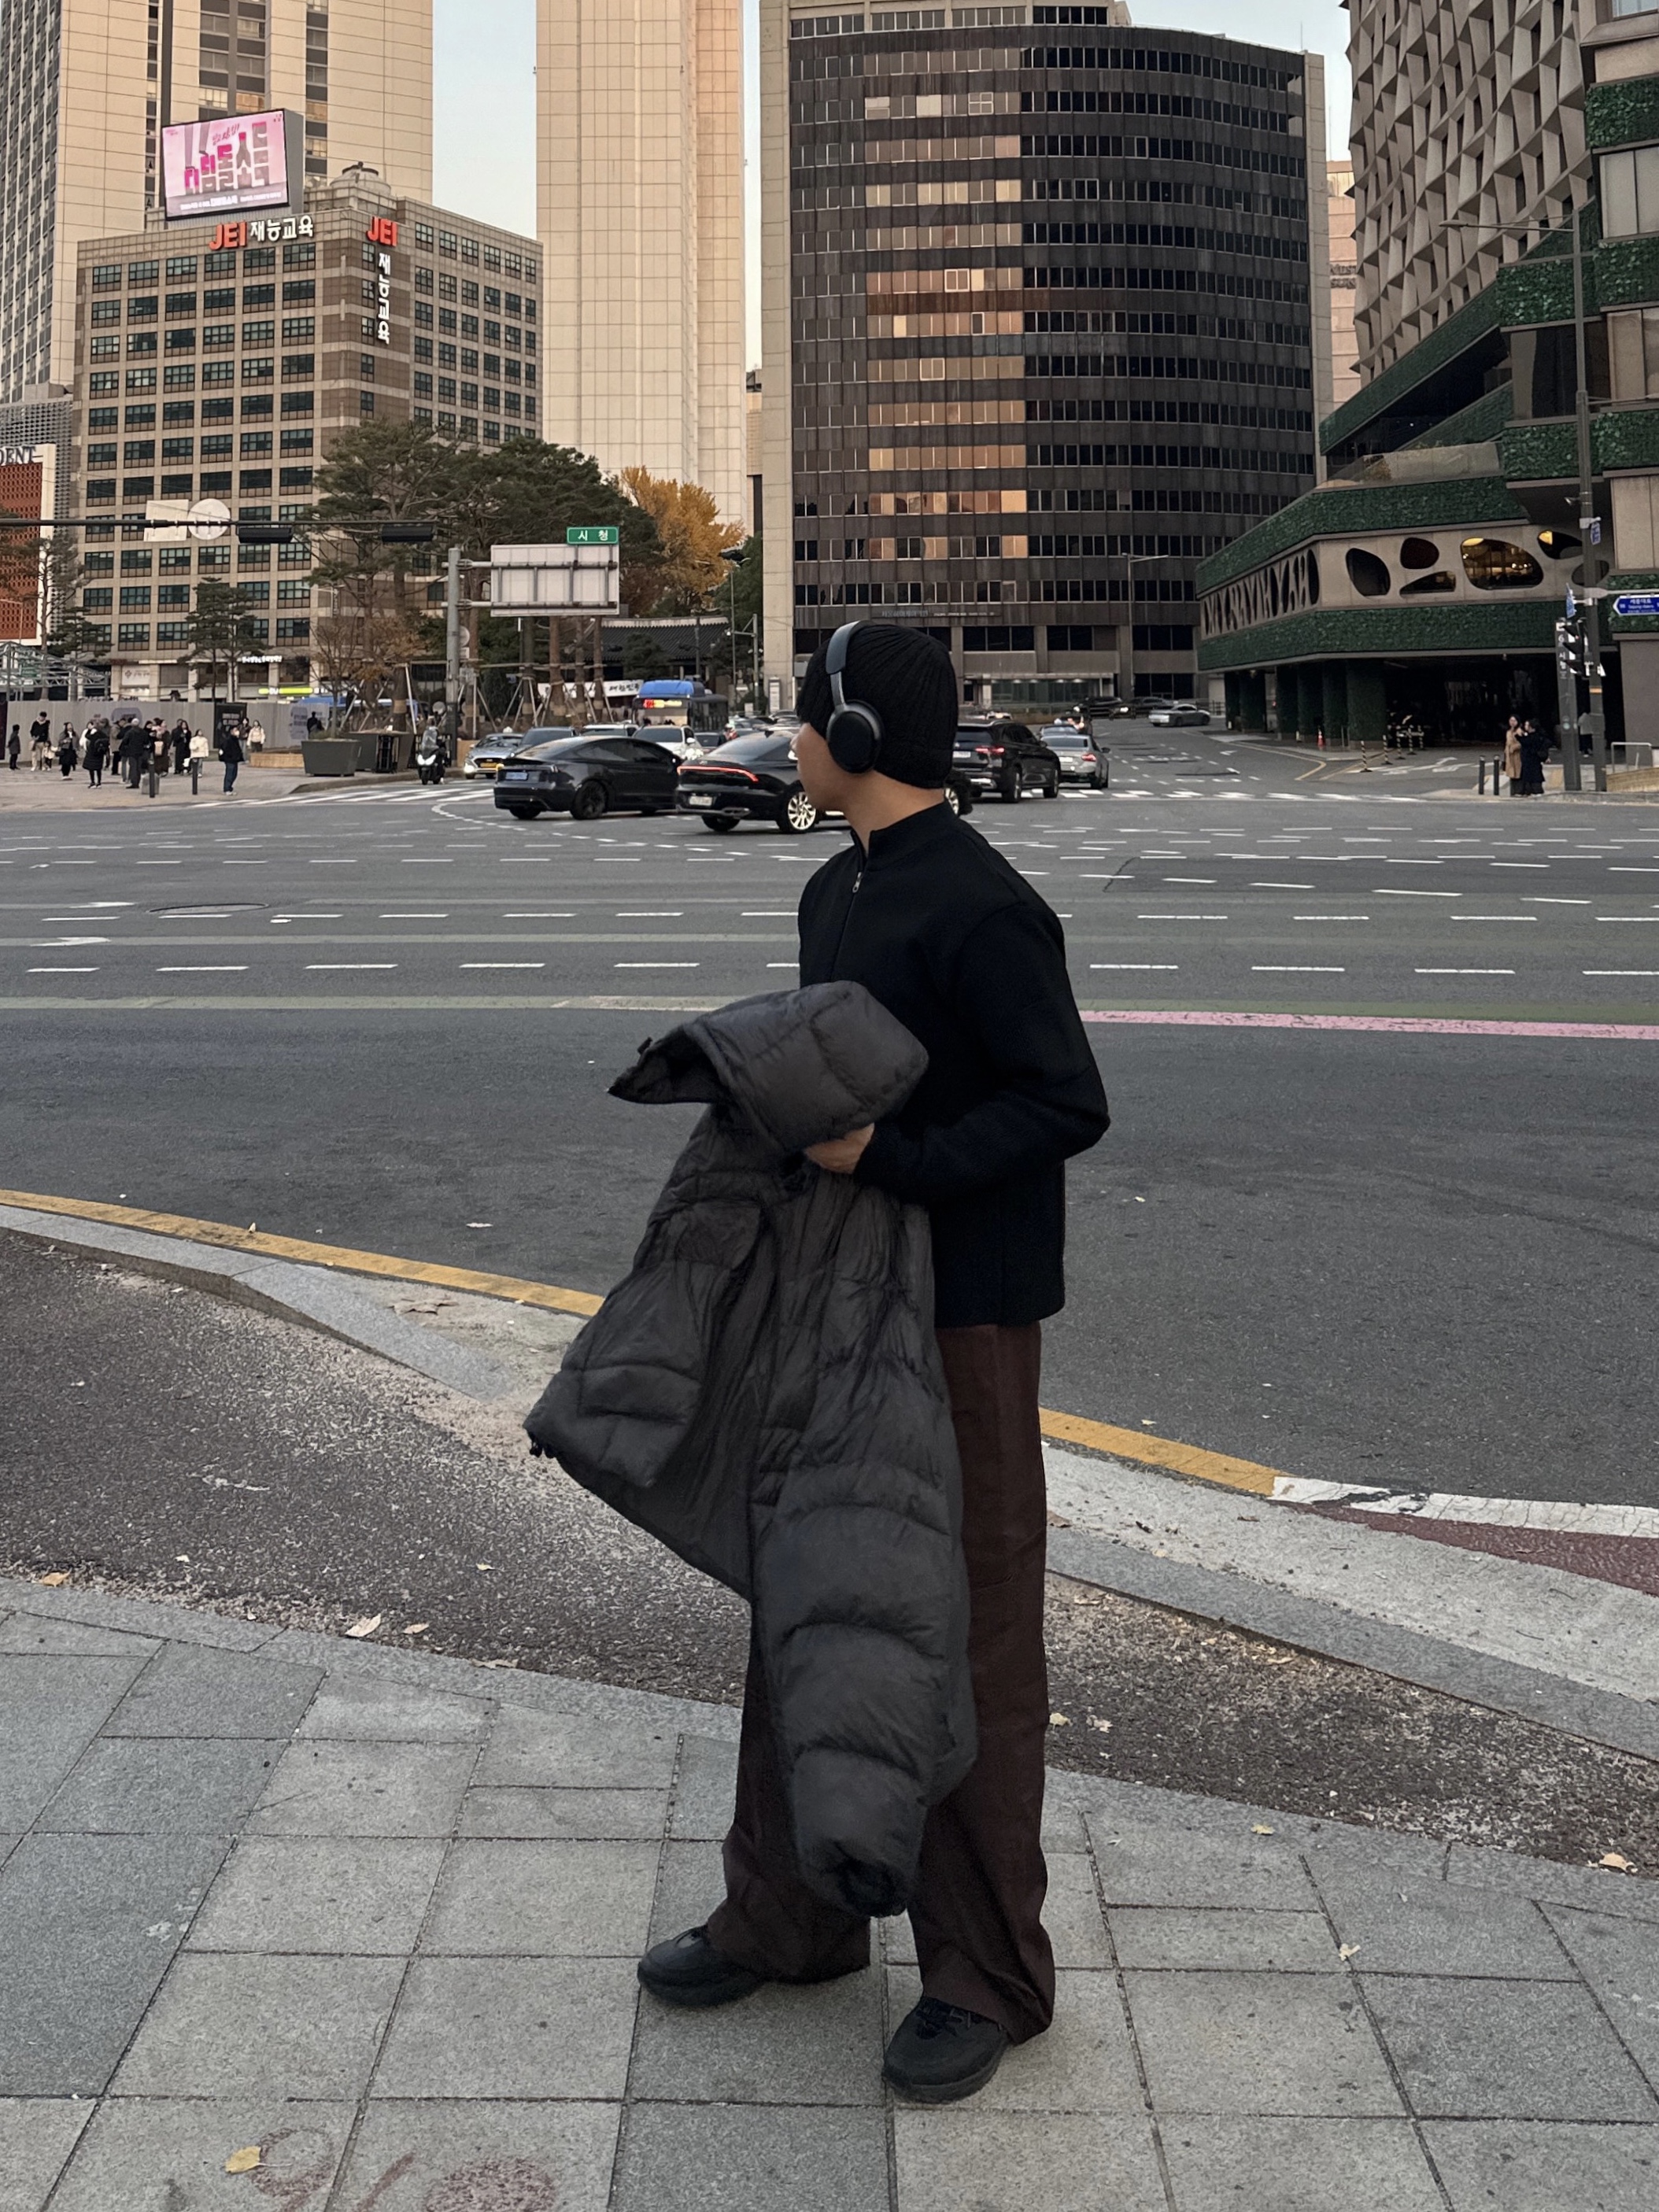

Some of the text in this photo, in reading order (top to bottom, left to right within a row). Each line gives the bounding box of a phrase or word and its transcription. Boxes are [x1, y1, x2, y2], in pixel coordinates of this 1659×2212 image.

[209, 215, 313, 250] JEI 재능교육
[367, 216, 399, 246] JEI
[378, 253, 391, 345] 재능교육
